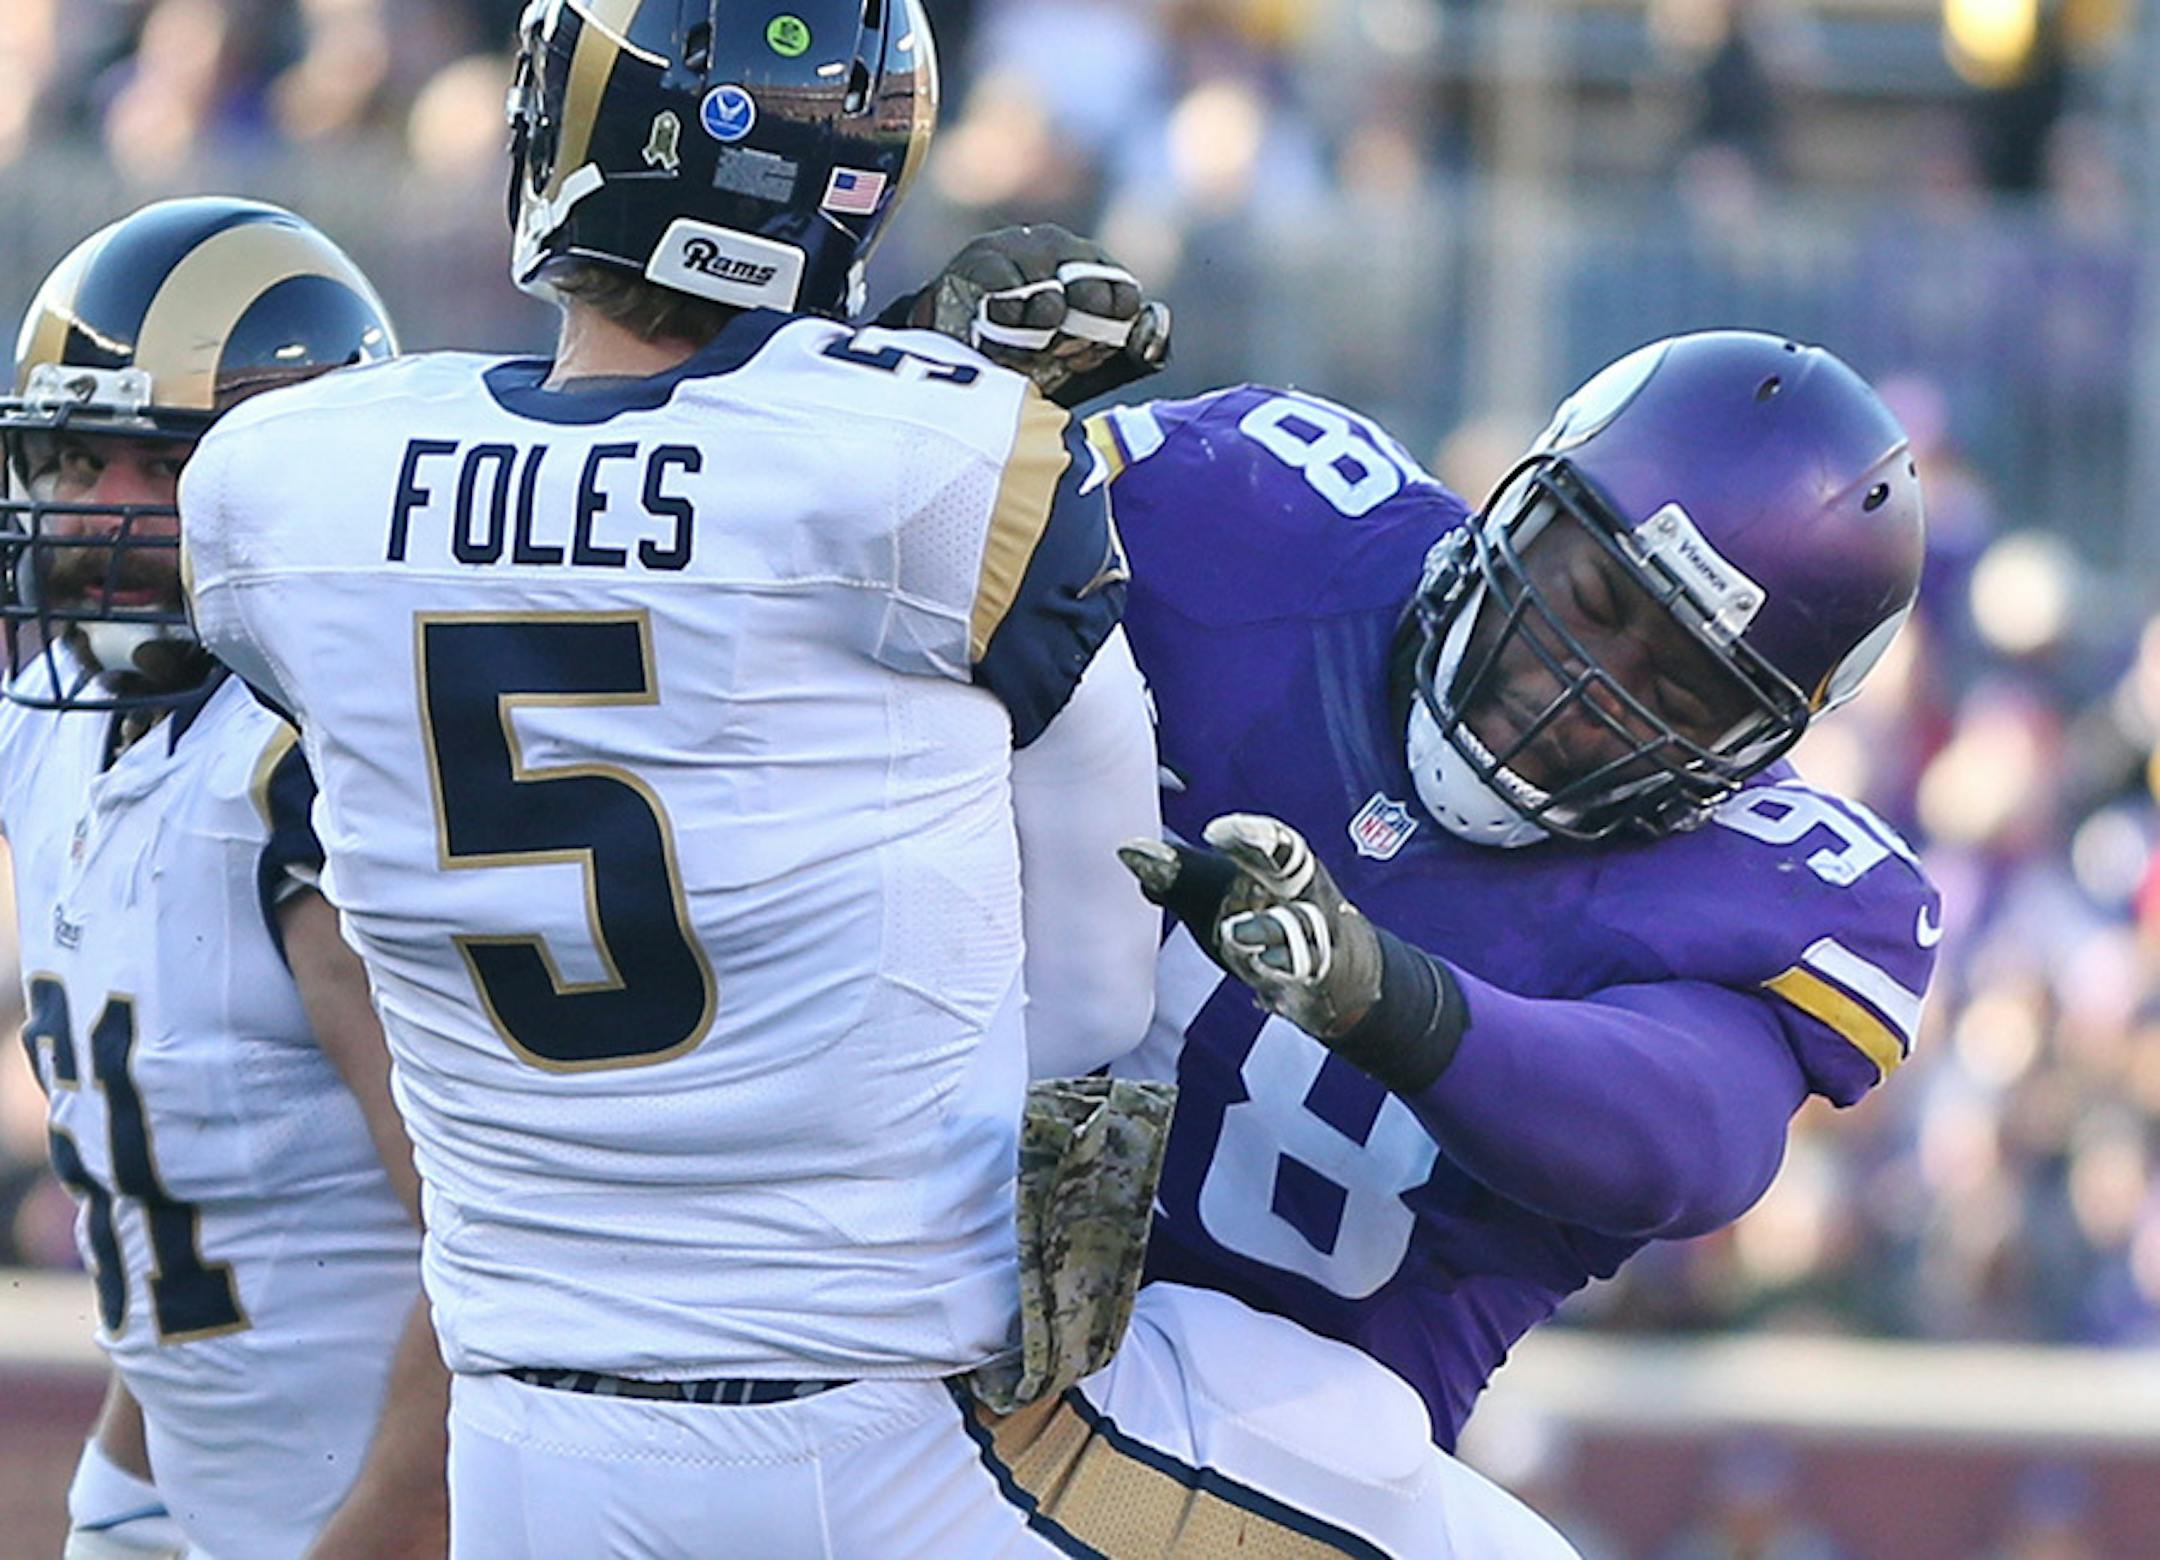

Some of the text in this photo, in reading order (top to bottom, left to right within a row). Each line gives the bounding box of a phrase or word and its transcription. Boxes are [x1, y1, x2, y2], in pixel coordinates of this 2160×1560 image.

[683, 238, 778, 287] Rams
[386, 438, 702, 571] FOLES
[412, 609, 718, 1074] 5
